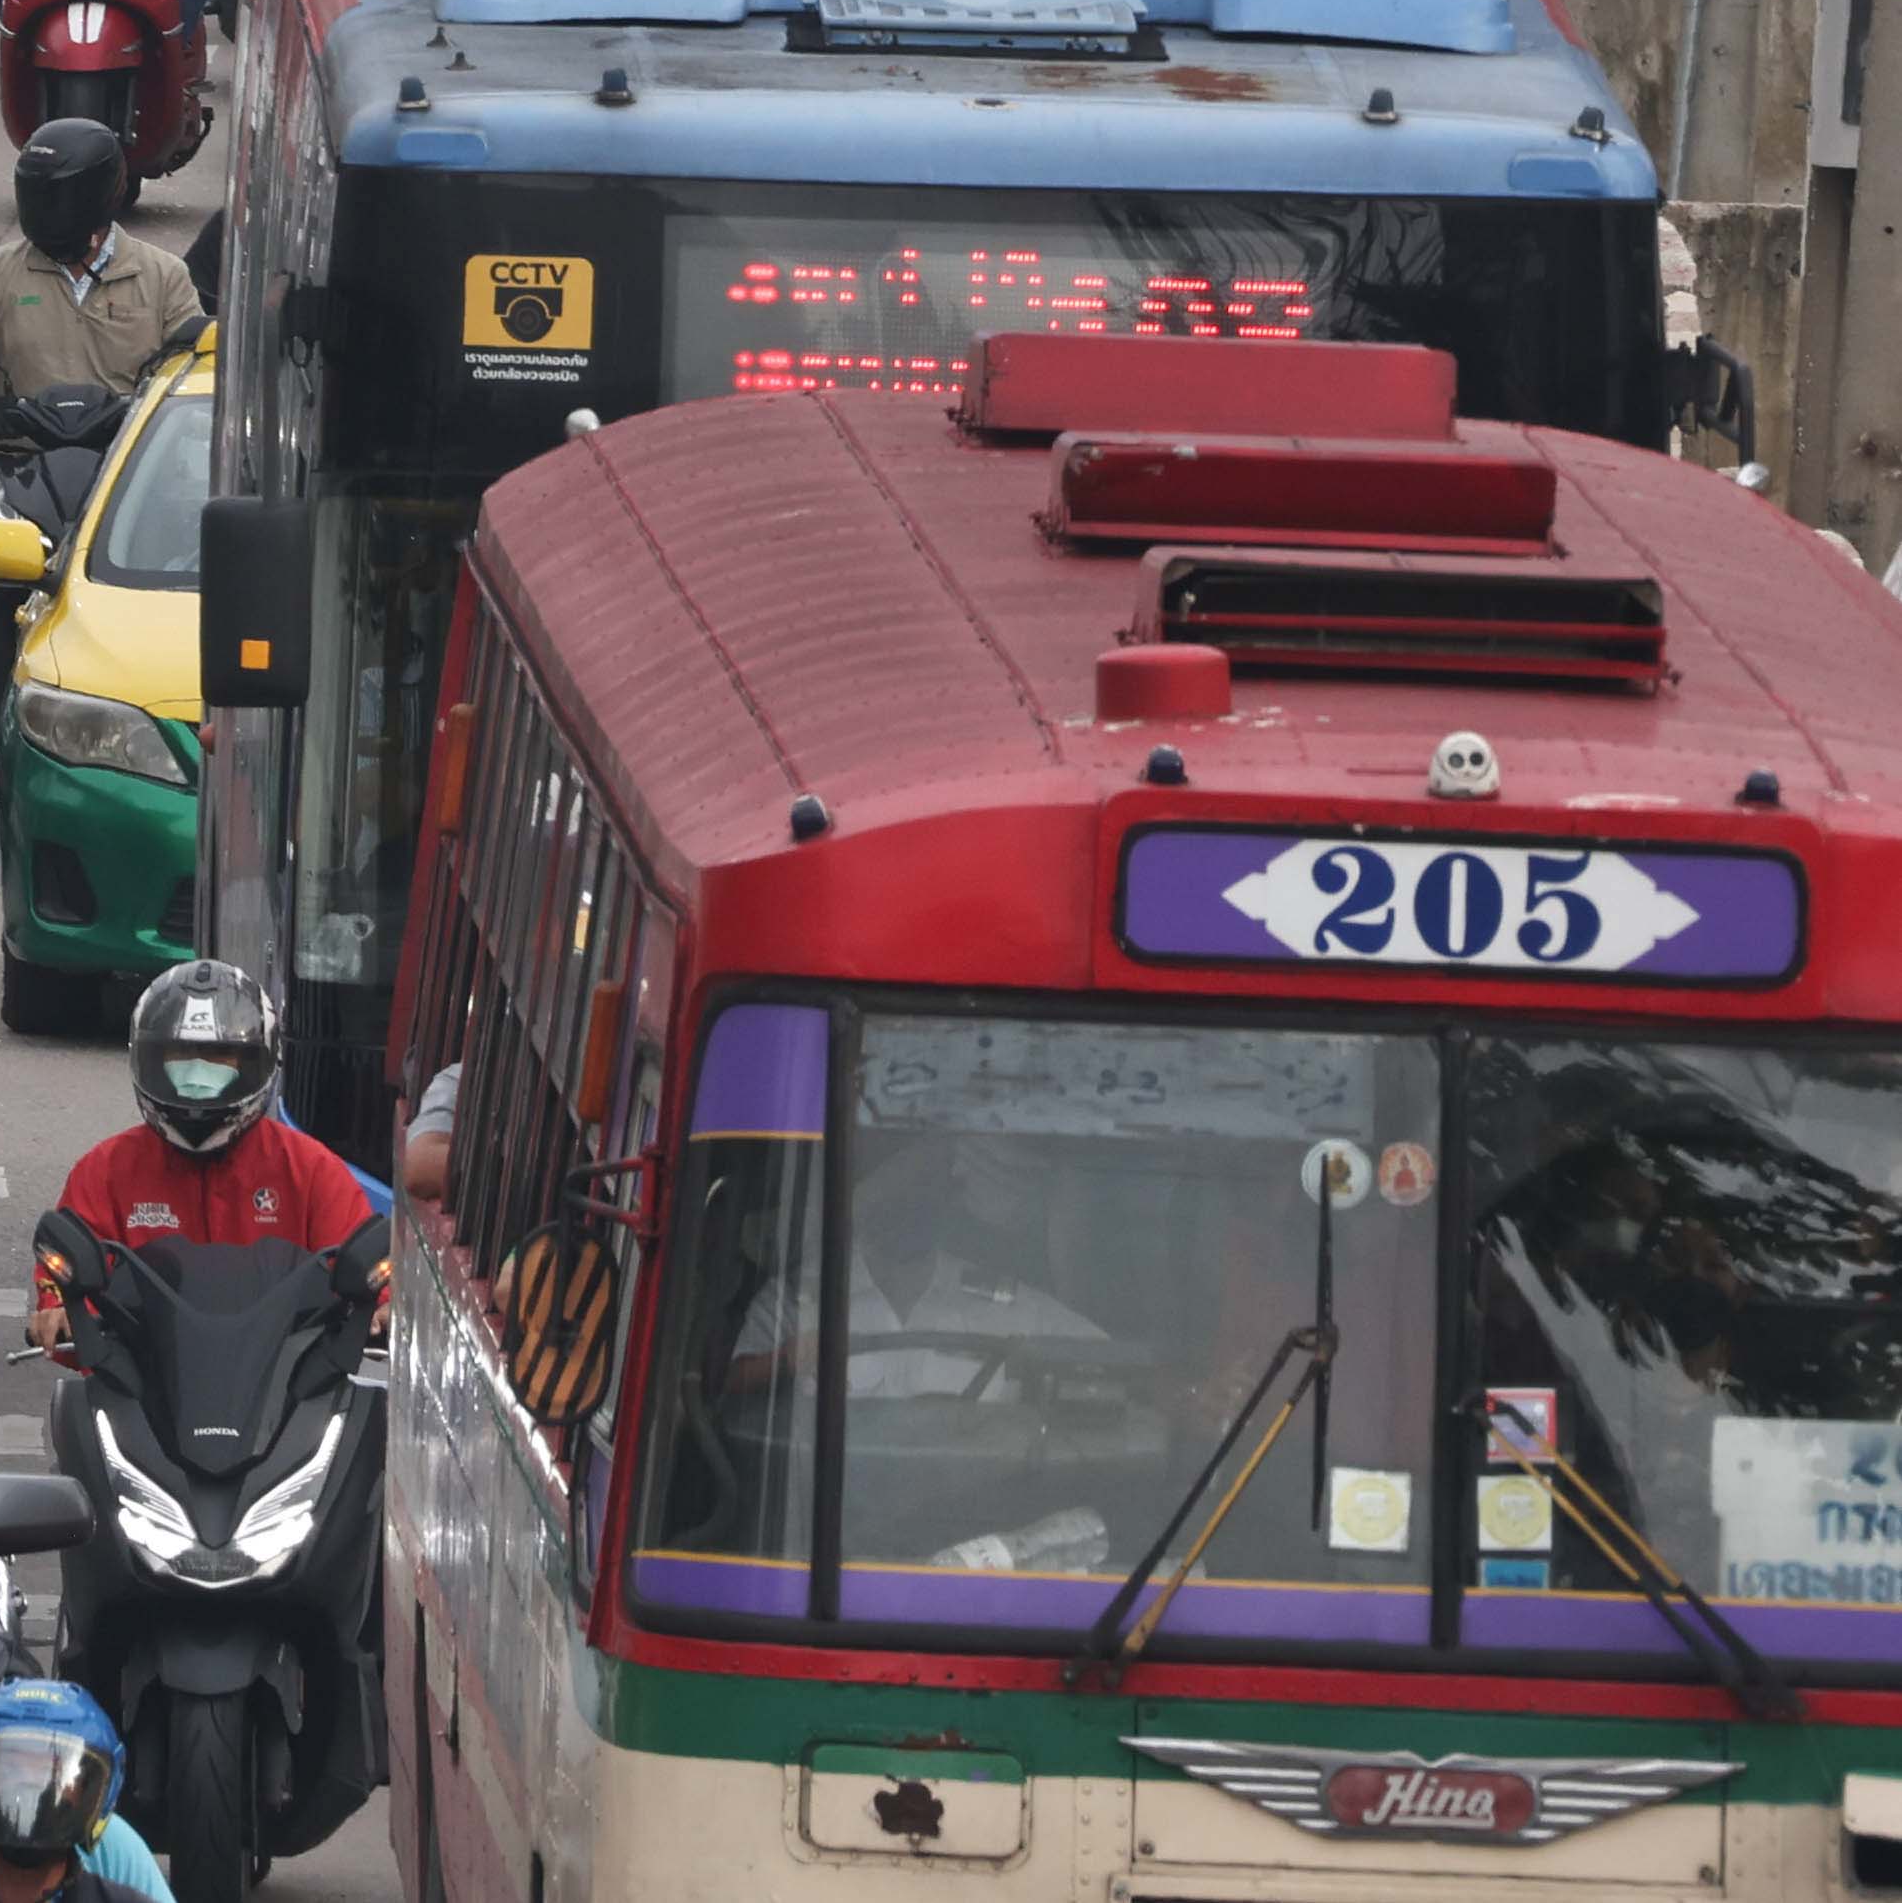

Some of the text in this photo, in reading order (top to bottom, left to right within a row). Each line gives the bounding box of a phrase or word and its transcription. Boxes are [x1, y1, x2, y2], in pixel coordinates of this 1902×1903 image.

[490, 261, 569, 285] CCTV
[464, 352, 588, 368] เราดูแลความปลอดภัย
[472, 366, 580, 383] ด้วยกล้องวงจรปิด
[1310, 845, 1602, 963] 205
[193, 1427, 240, 1437] HONDA
[1363, 1769, 1495, 1825] Hino
